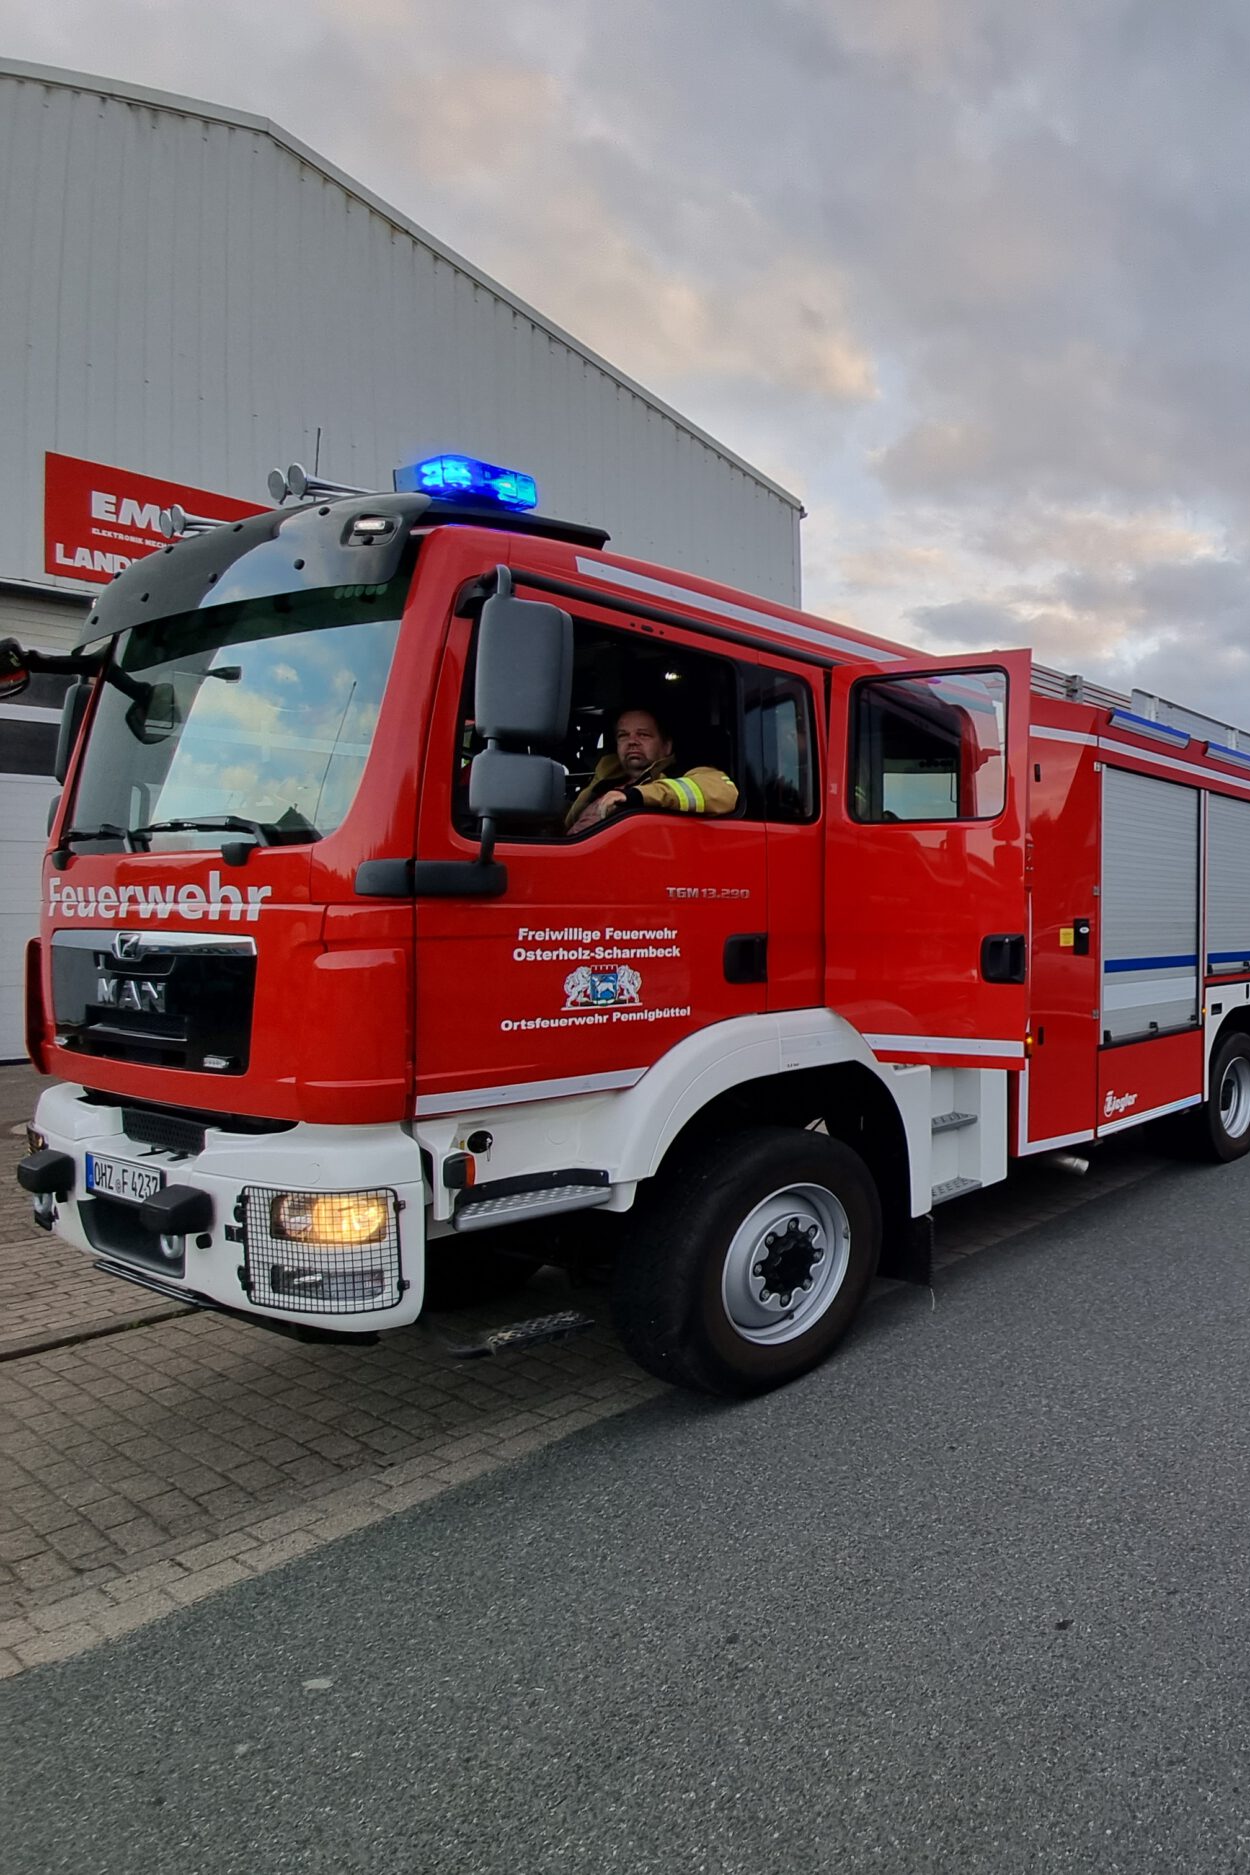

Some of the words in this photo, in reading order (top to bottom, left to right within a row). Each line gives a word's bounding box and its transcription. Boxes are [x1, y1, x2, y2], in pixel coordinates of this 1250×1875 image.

[91, 490, 208, 538] EM
[91, 527, 144, 545] ELEKTRONIK
[55, 543, 142, 573] LAND
[48, 870, 272, 922] Feuerwehr
[666, 887, 699, 898] TGM
[701, 888, 750, 899] 13.290
[518, 928, 601, 942] Freiwillige
[605, 928, 678, 940] Feuerwehr
[513, 946, 681, 961] Osterholz-Scharmbeck
[97, 977, 166, 1013] MAN
[500, 1013, 609, 1031] Ortsfeuerwehr
[612, 1006, 691, 1023] Pennigbüttel
[94, 1161, 114, 1190] OHZ
[122, 1168, 128, 1193] F
